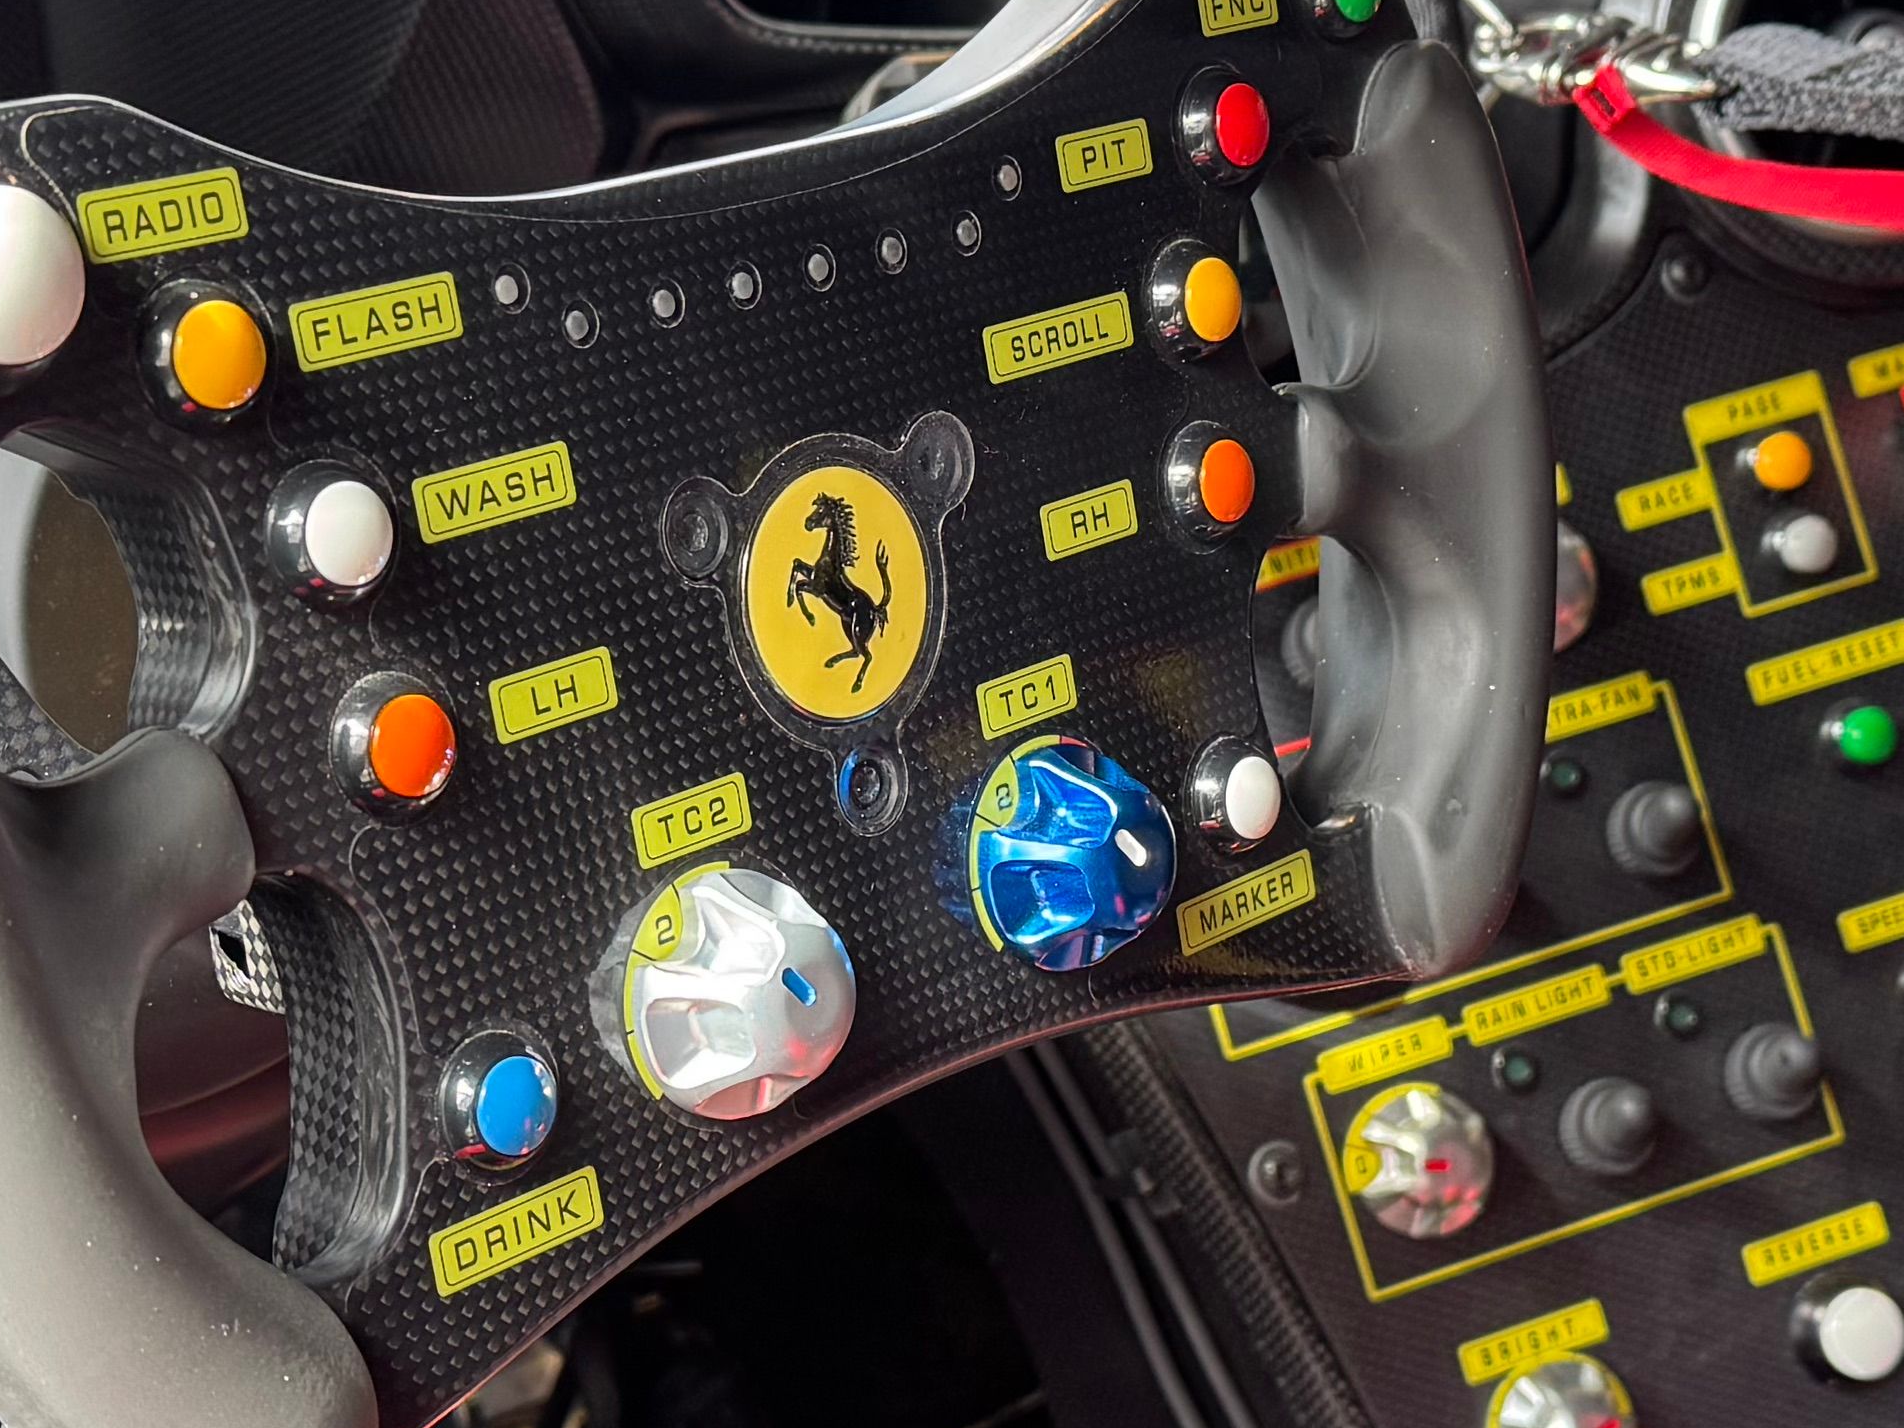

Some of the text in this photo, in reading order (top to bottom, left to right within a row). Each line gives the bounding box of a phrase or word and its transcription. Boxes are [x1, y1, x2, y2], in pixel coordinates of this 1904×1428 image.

[1080, 139, 1127, 174] PIT
[102, 189, 227, 245] RADIO
[309, 291, 447, 351] FLASH
[1010, 315, 1110, 364] SCROLL
[1726, 390, 1782, 422] PAGE
[435, 461, 557, 521] WASH
[1637, 482, 1695, 512] RACE
[1070, 500, 1111, 538] RH
[1661, 565, 1722, 600] TPMS
[530, 673, 582, 717] LH
[998, 674, 1057, 717] TC1
[1549, 682, 1641, 726] TRA-FAN
[996, 782, 1014, 812] 2
[657, 796, 729, 844] TC2
[1199, 871, 1296, 934] MARKER
[655, 914, 676, 946] 2
[1475, 975, 1596, 1032] RAIN LIGHT
[1347, 1032, 1423, 1072] WIPER
[454, 1189, 582, 1271] DRINK
[1762, 1216, 1865, 1267] REVERSE
[1479, 1317, 1576, 1368] BRIGHT
